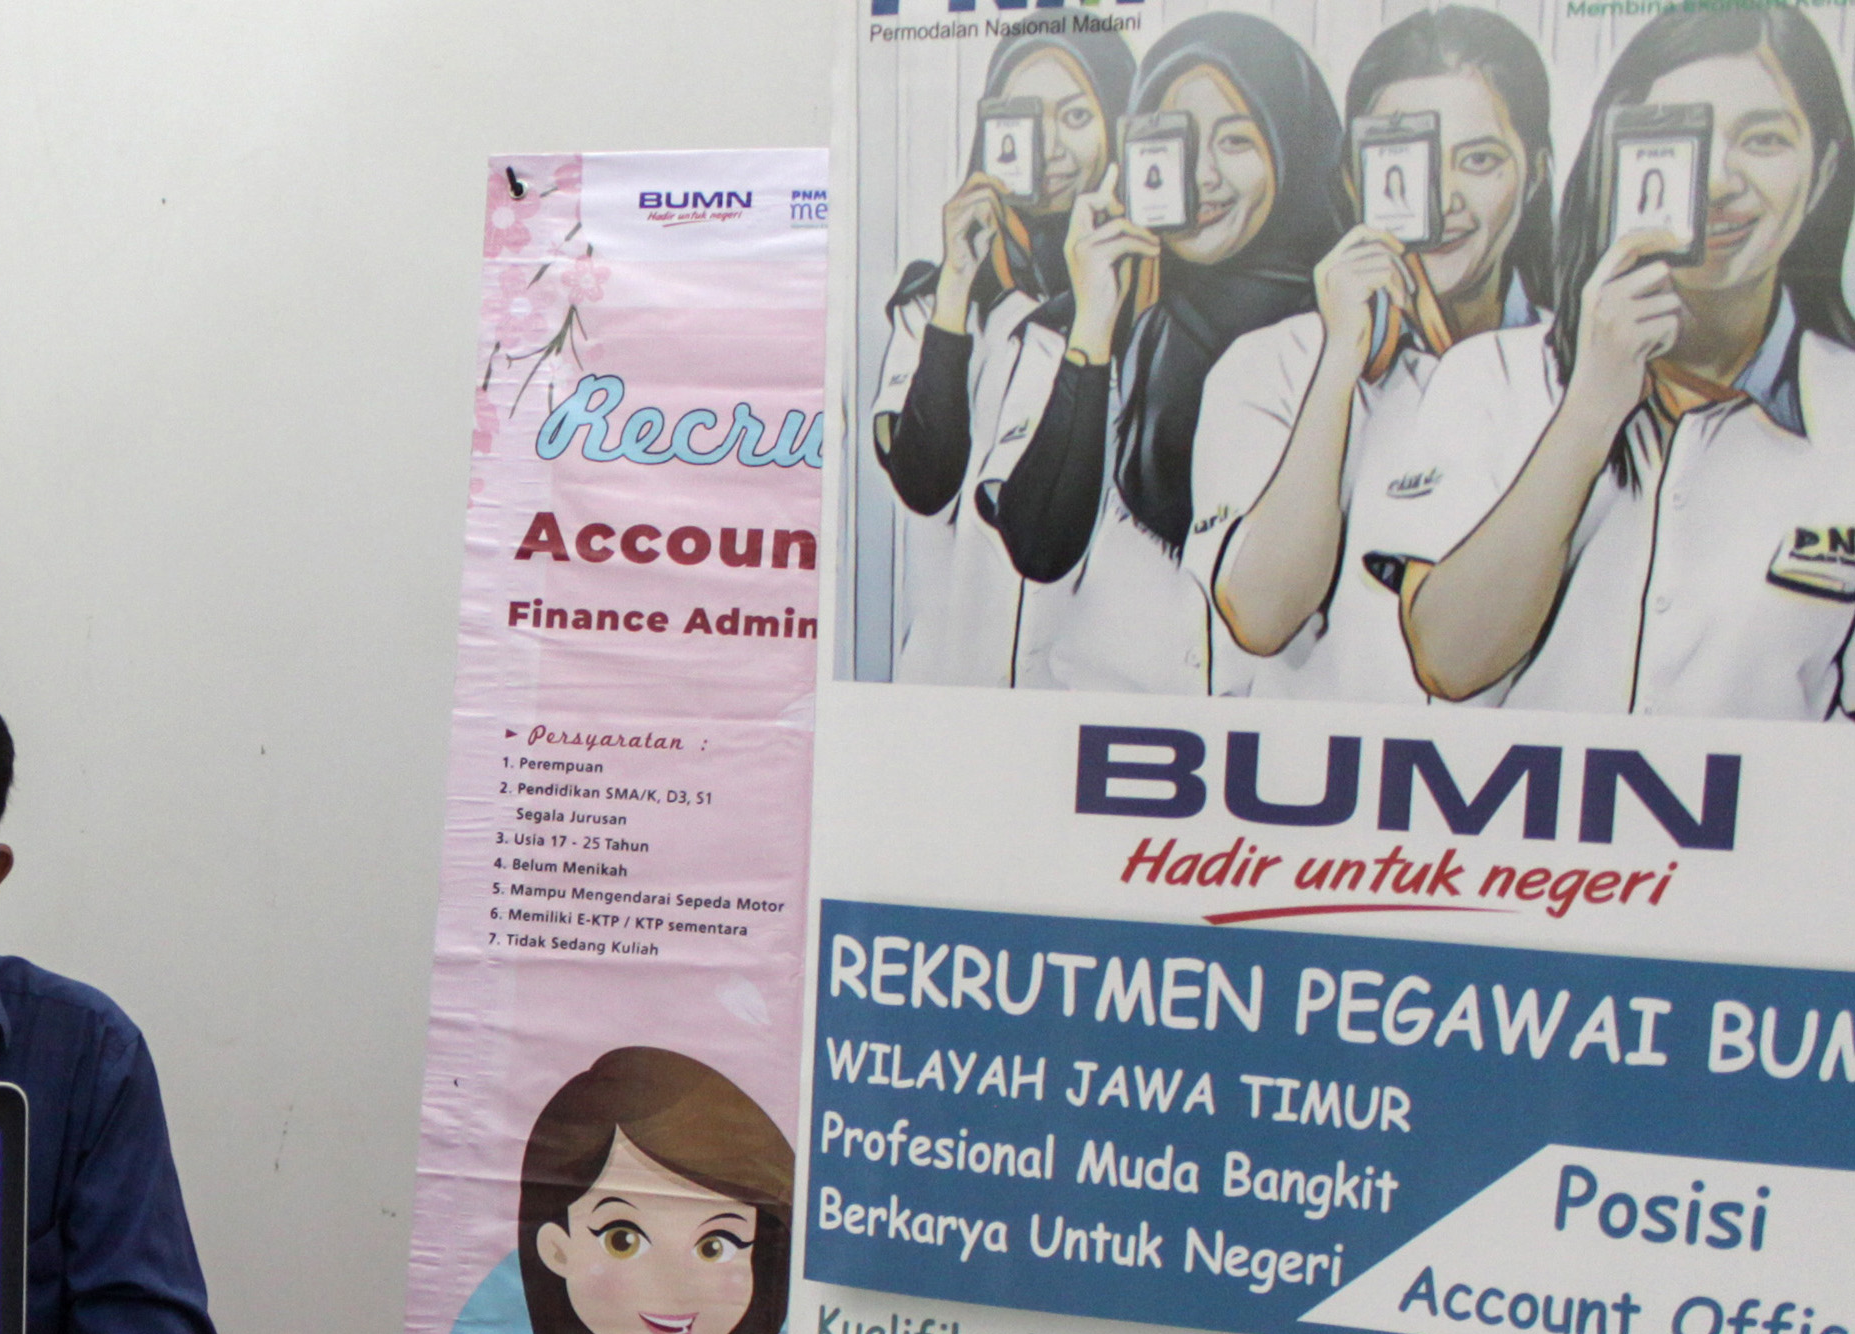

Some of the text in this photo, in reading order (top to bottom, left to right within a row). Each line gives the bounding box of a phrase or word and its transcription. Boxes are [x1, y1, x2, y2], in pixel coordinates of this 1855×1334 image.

[870, 13, 1141, 42] Permodalan Nasional Madani
[639, 192, 752, 208] BUMN
[792, 191, 826, 199] PNM
[648, 211, 742, 221] Hadir untuk negeri
[515, 512, 817, 570] Accoun
[509, 599, 817, 639] Finance Admin
[528, 725, 683, 751] Persyaratan
[520, 757, 603, 774] Perempuan
[518, 783, 660, 803] Pendidikan SMA/K,
[1076, 725, 1741, 851] BUMN
[517, 808, 626, 824] Segala Jurusan
[515, 834, 648, 852] Usia Tahun
[513, 859, 627, 876] Belum Menikah
[1121, 837, 1677, 918] Hadir untuk negeri
[511, 884, 784, 912] Mampu Mengendarai Sepeda Motor
[509, 909, 747, 936] Memiliki E-KTP KTP sementara
[507, 934, 658, 955] Tidak Sedang Kuliah
[831, 934, 1262, 1032] REKRUTMEN
[1296, 968, 1671, 1065] PEGAWAI
[827, 1037, 1410, 1132] WILAYAH JAWA TIMUR
[822, 1111, 1398, 1219] Profesional Muda Bangkit
[1555, 1165, 1770, 1251] Posisi
[819, 1186, 1343, 1293] Berkarya Untuk Negeri
